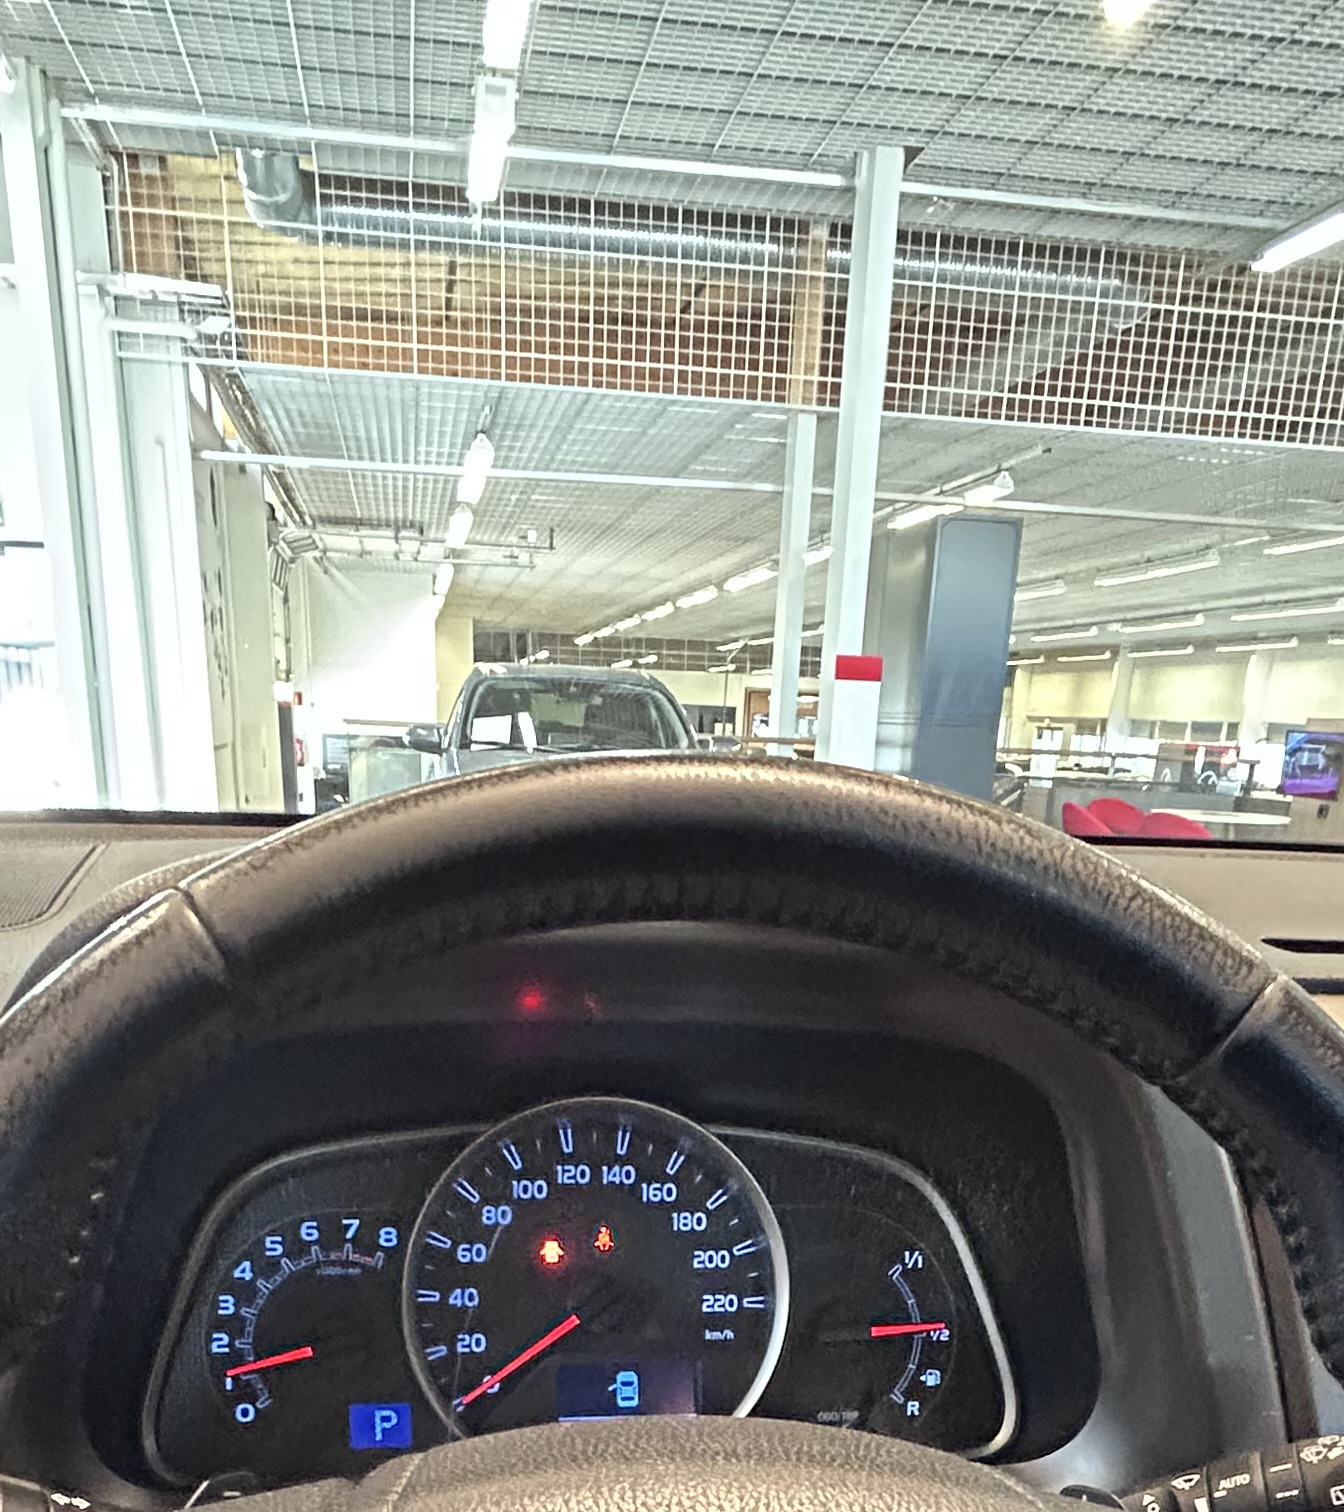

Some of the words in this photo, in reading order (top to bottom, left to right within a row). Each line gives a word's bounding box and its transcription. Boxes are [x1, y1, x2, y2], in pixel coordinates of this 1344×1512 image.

[556, 1164, 591, 1185] 120
[601, 1164, 636, 1185] 140
[511, 1179, 548, 1200] 100
[640, 1182, 677, 1203] 160
[481, 1205, 513, 1226] 80
[671, 1211, 708, 1232] 180
[299, 1221, 320, 1242] 6
[341, 1218, 361, 1240] 7
[378, 1226, 399, 1247] 8
[264, 1236, 284, 1256] 5
[456, 1243, 488, 1264] 60
[692, 1250, 731, 1269] 200
[233, 1260, 254, 1281] 4
[217, 1294, 236, 1315] 3
[448, 1286, 480, 1307] 40
[701, 1293, 739, 1313] 220
[210, 1332, 230, 1354] 2
[456, 1333, 487, 1354] 20
[704, 1328, 735, 1341] km/h
[234, 1402, 256, 1423] 0
[906, 1400, 920, 1417] R
[374, 1408, 399, 1442] P
[1218, 1473, 1251, 1490] AUTO
